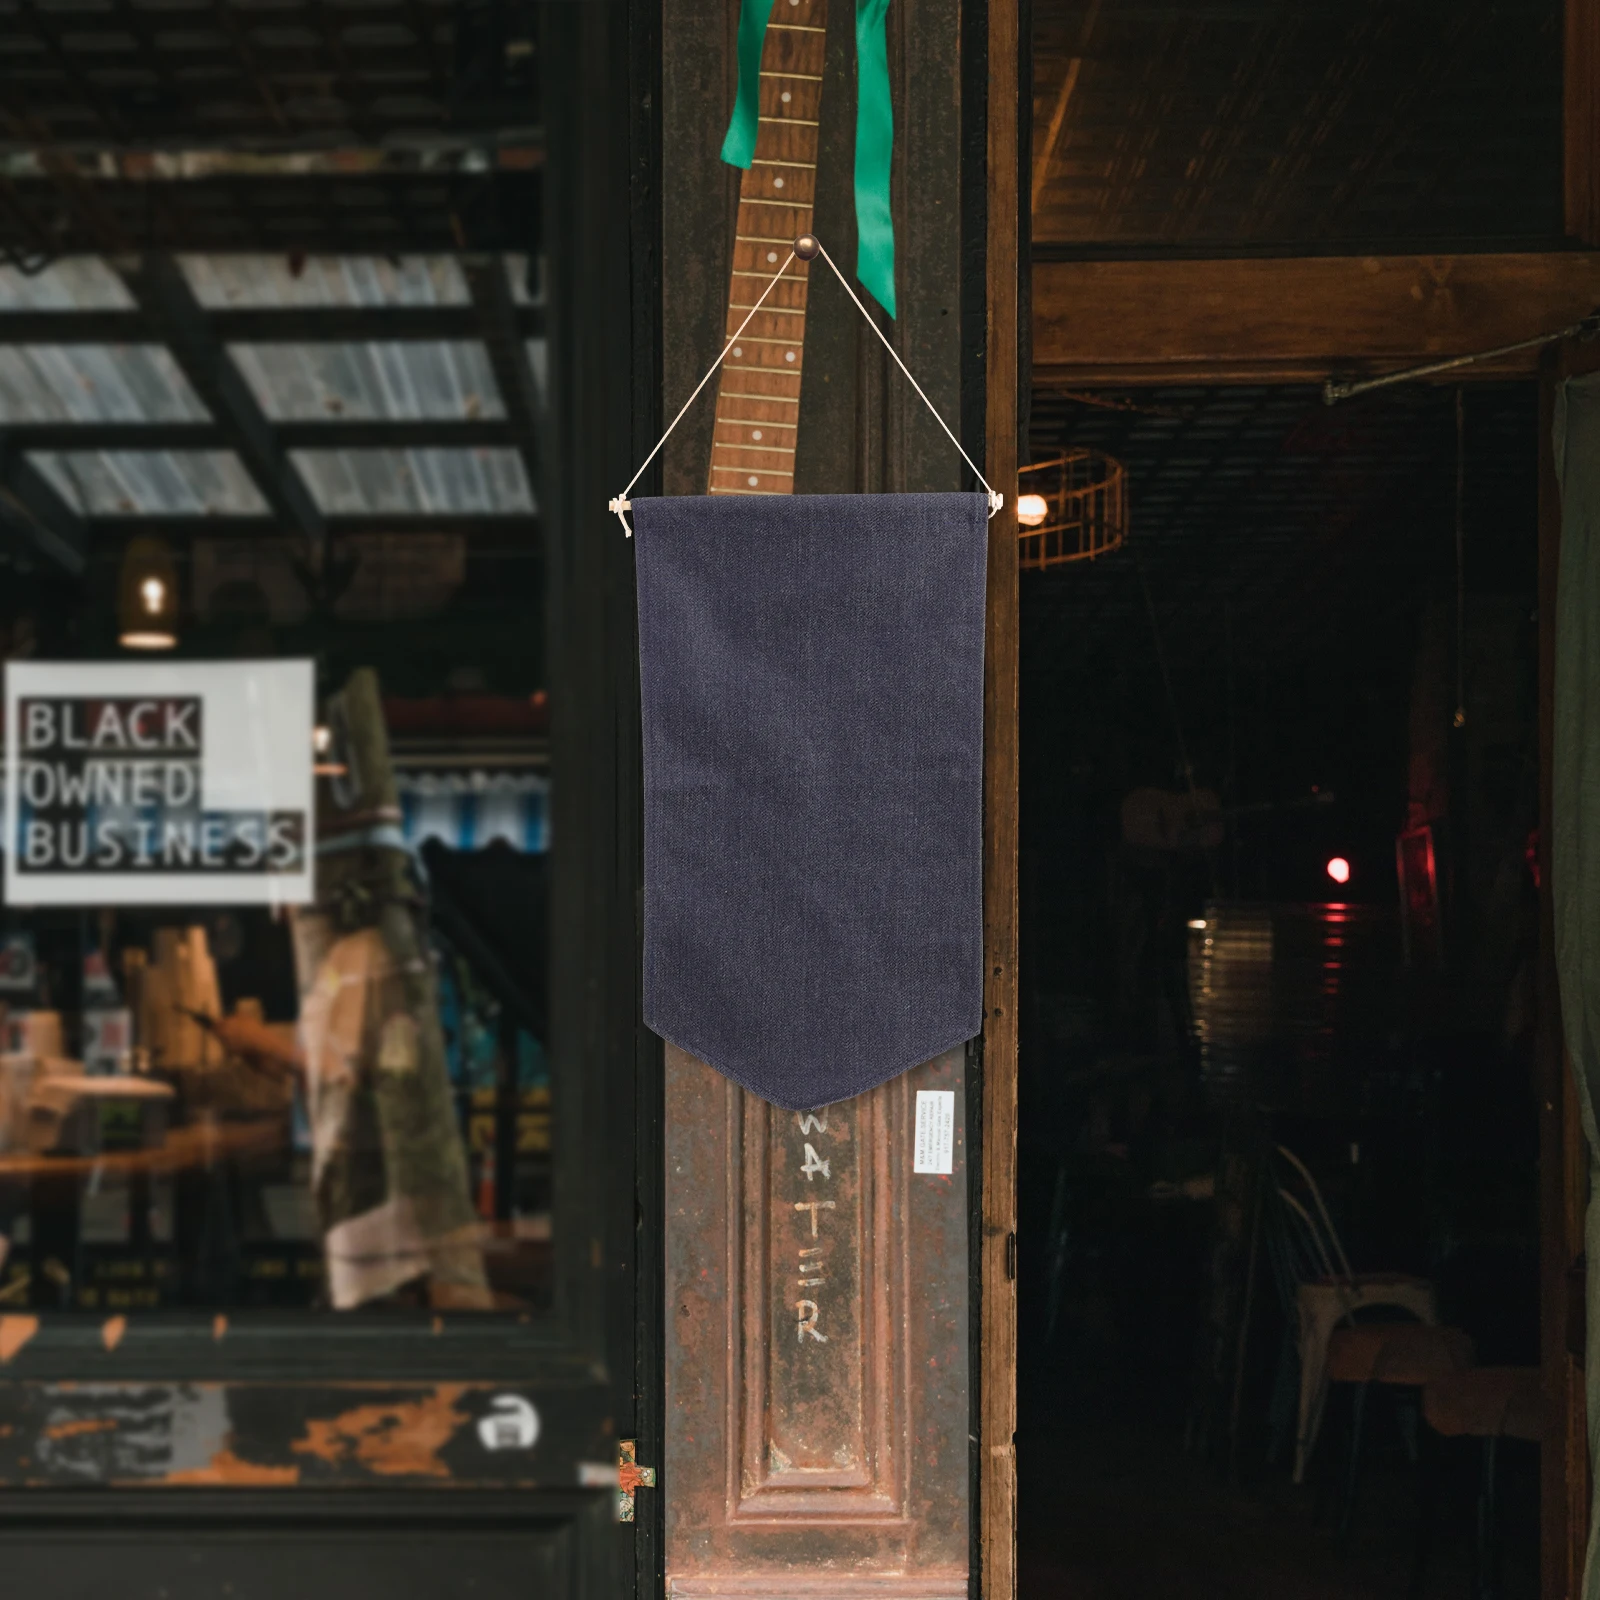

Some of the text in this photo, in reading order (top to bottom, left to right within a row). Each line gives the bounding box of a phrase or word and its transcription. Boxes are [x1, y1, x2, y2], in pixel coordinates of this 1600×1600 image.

[26, 703, 198, 748] BLACK
[24, 760, 195, 808] OWNED
[25, 820, 298, 866] BUSINESS
[794, 1106, 836, 1343] WATER
